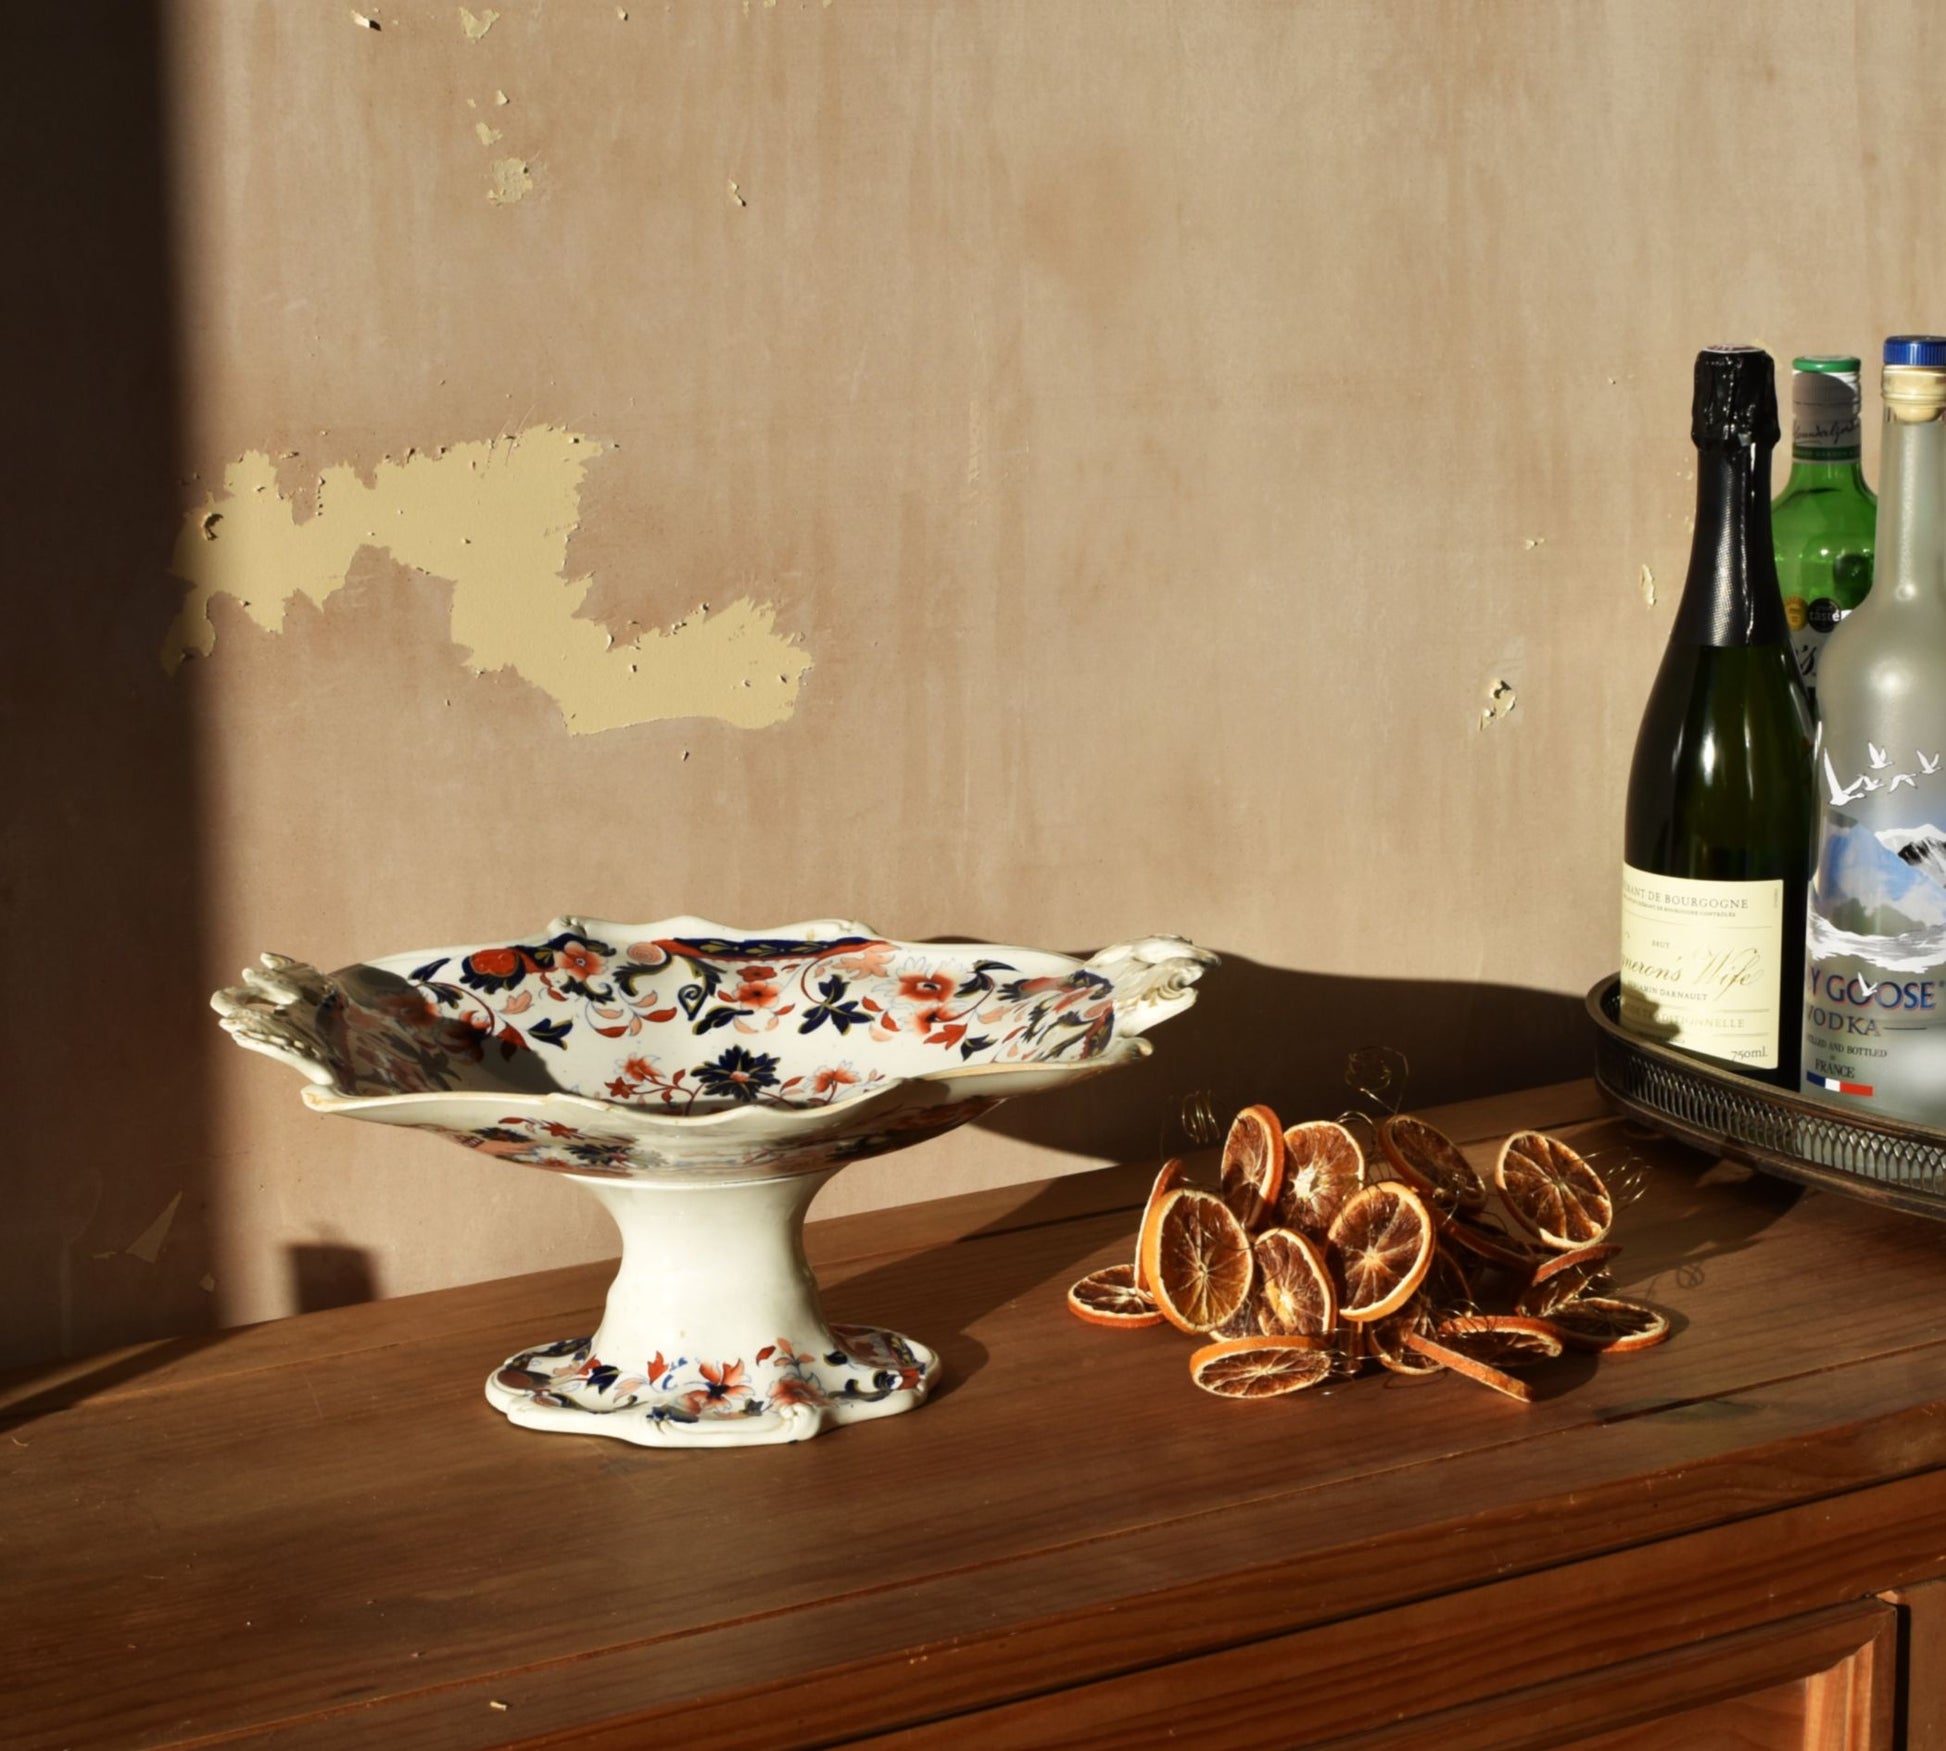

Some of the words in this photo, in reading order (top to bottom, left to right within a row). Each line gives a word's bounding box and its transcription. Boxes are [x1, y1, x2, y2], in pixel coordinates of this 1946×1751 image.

[1648, 890, 1661, 902] DE
[1664, 894, 1749, 909] BOURGOGNE
[1825, 974, 1936, 1010] GOOSE
[1828, 1042, 1845, 1054] AND
[1846, 1045, 1888, 1058] BOTTLED
[1815, 1058, 1855, 1079] FRANCE
